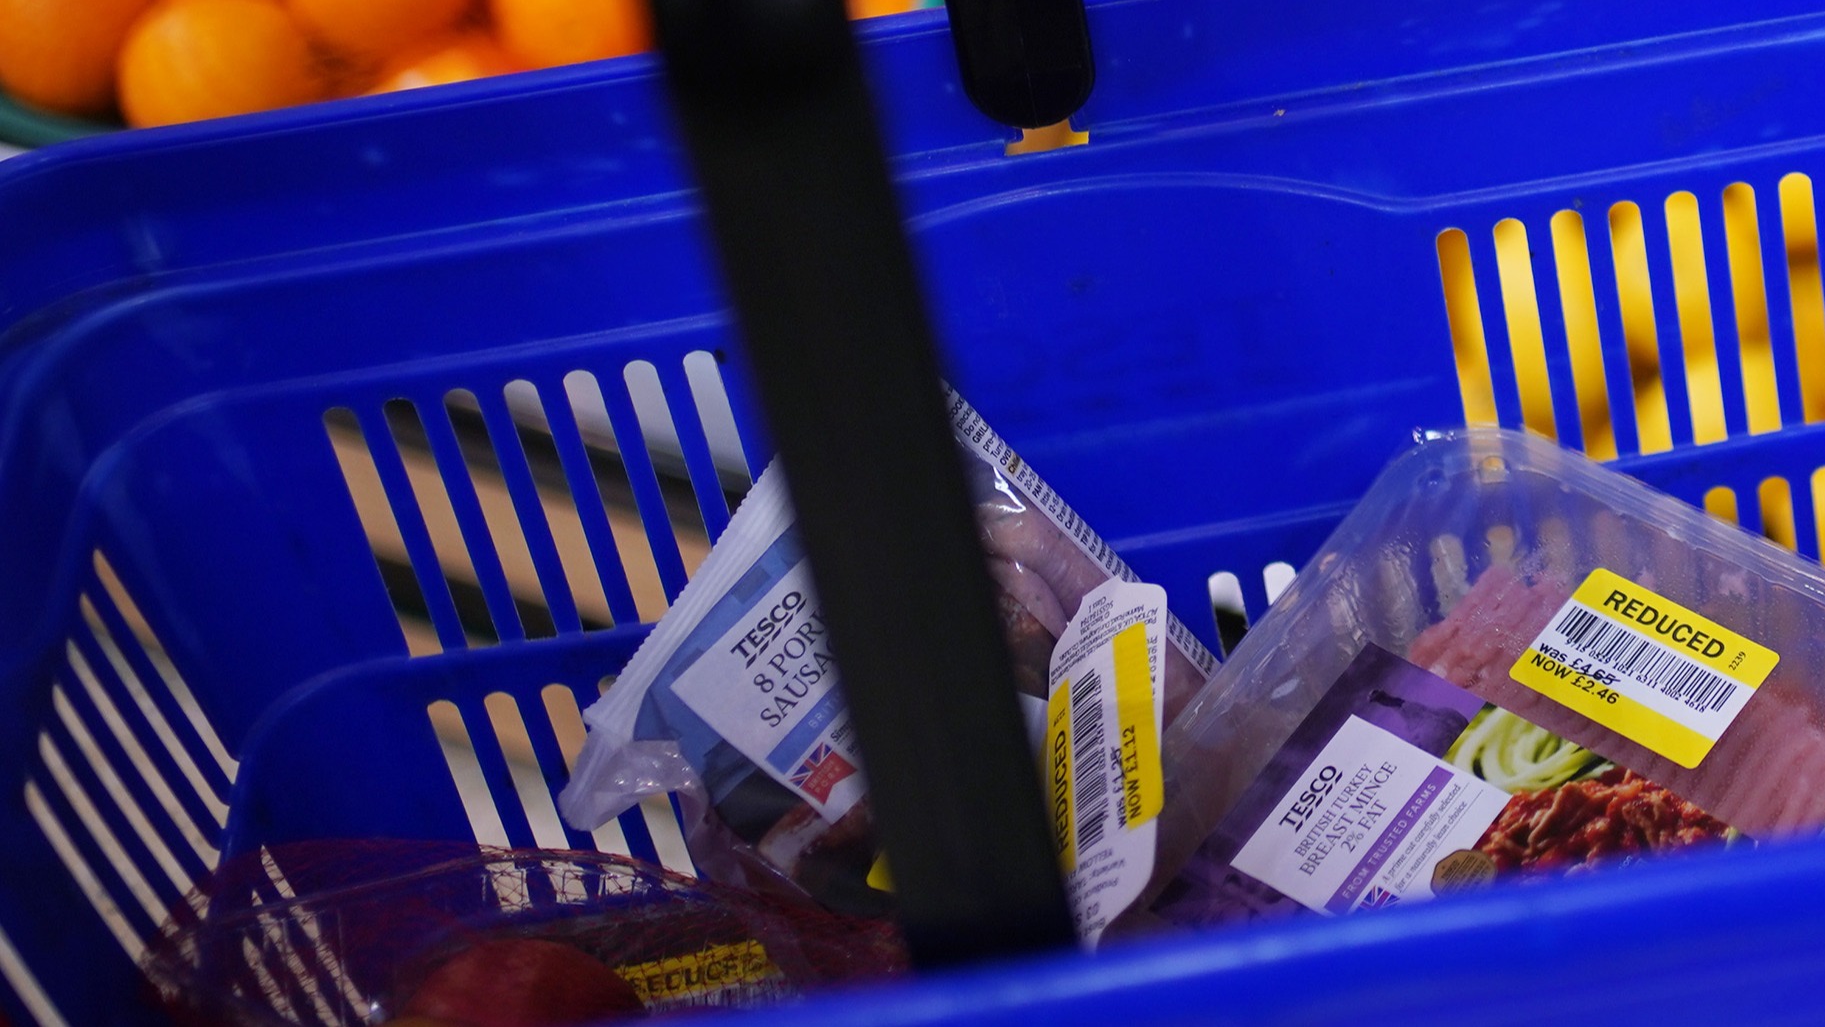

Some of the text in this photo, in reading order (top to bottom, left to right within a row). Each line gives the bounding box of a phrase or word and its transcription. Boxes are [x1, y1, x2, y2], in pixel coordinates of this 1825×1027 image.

[730, 591, 802, 659] TESCO
[1539, 642, 1568, 664] was
[1603, 589, 1725, 658] REDUCED
[753, 673, 775, 693] 8
[760, 637, 834, 728] SAUSA
[1531, 653, 1620, 705] NOW £2.46
[1728, 651, 1746, 671] 2239
[1054, 730, 1069, 855] REDUCED
[1122, 724, 1142, 820] NOW £1.12
[1278, 765, 1338, 829] TESCO
[1294, 763, 1374, 858] BRITISH TURKEY
[1298, 761, 1398, 877] BREAST MINCE
[1340, 799, 1388, 853] 2% FAT
[1342, 783, 1437, 900] FROM TRUSTED FARMS
[1388, 855, 1407, 878] prime
[1405, 841, 1416, 859] cut
[1414, 811, 1440, 843] carefully
[1438, 783, 1461, 813] selected
[1410, 839, 1437, 873] naturally
[1436, 823, 1450, 841] lean
[1447, 801, 1468, 825] choice
